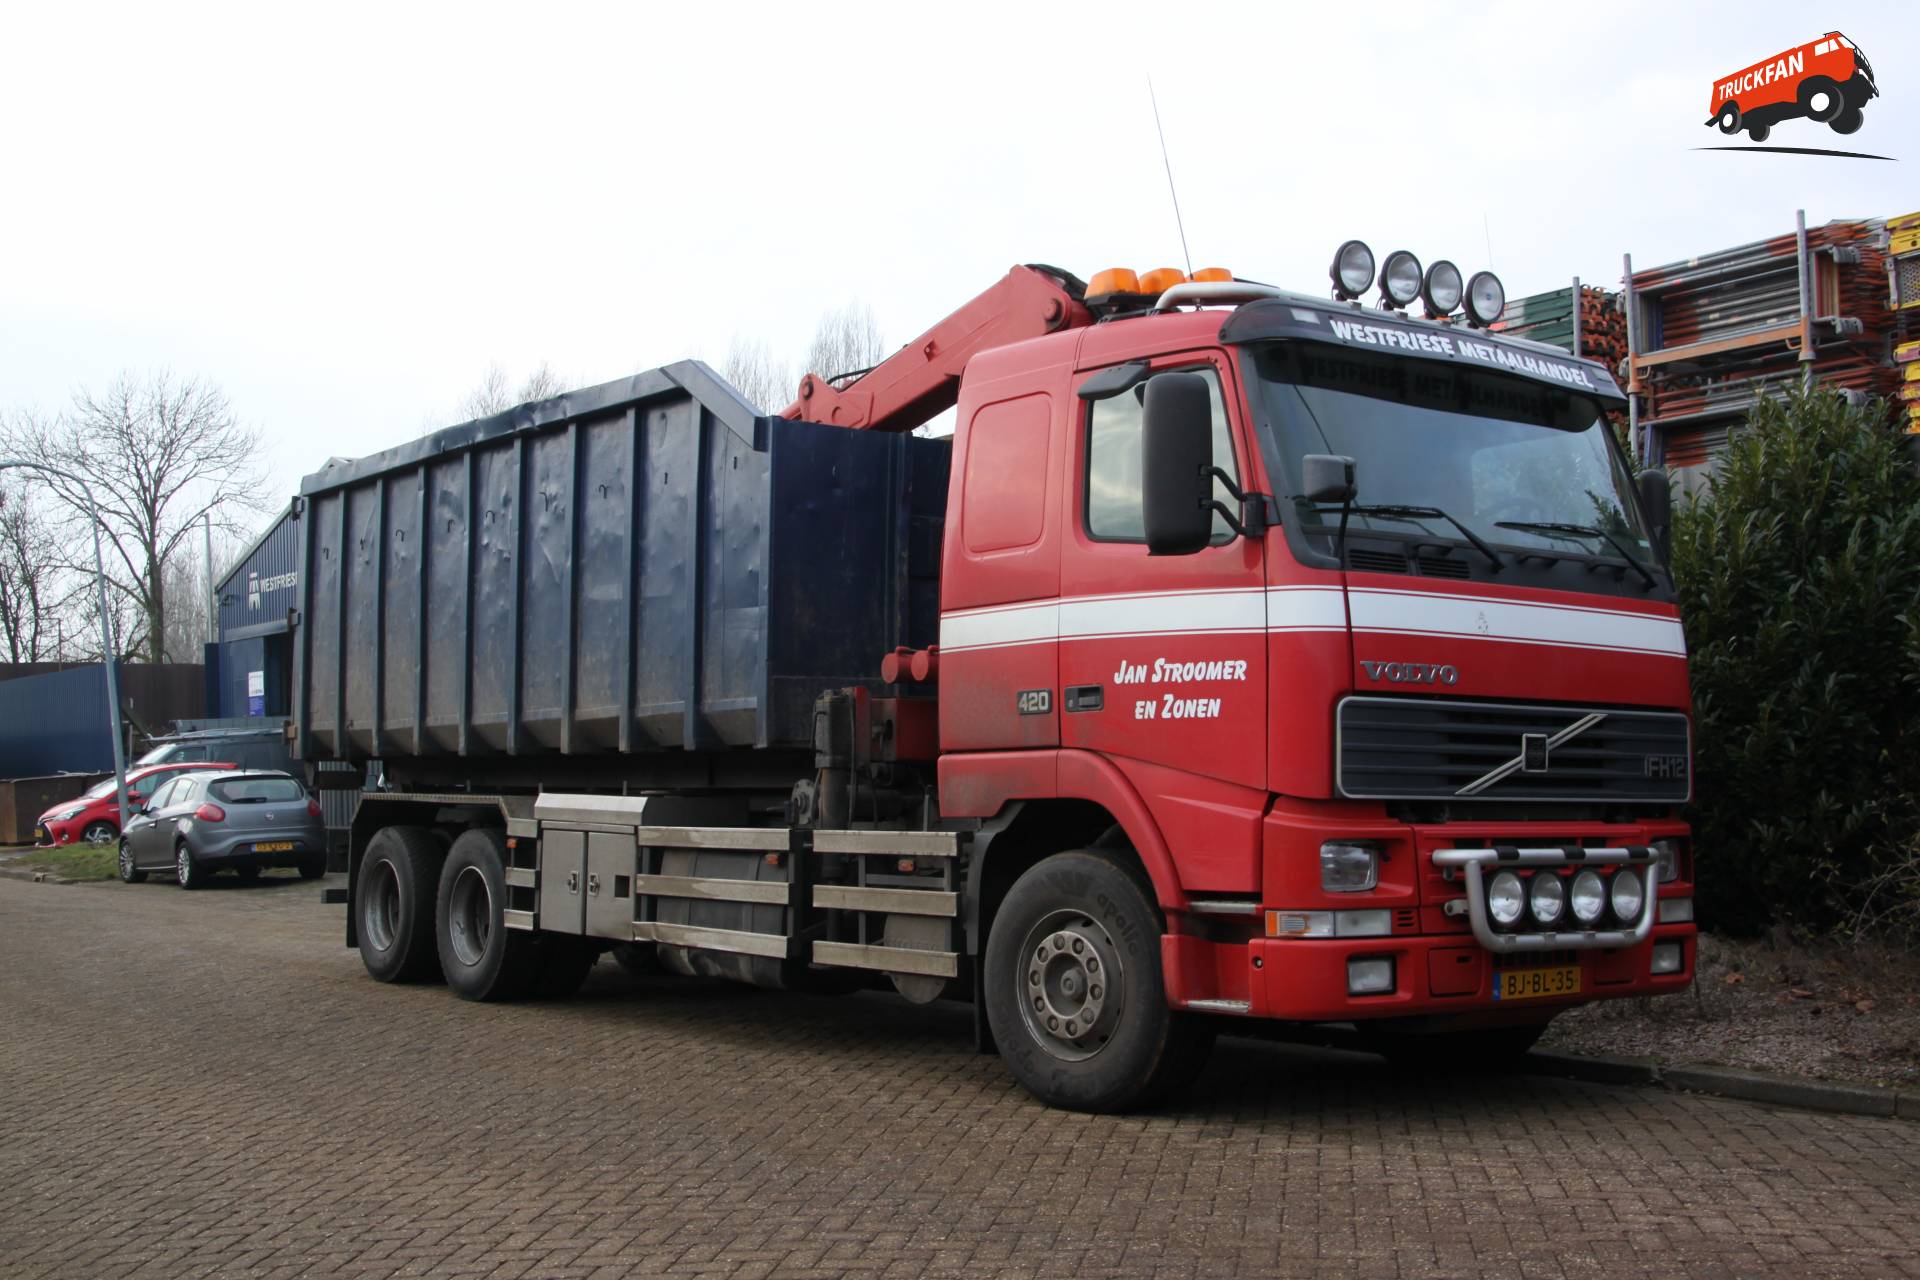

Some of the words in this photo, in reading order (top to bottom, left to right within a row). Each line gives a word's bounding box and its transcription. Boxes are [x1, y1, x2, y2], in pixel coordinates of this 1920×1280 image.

[1329, 319, 1455, 355] WESTFRIESE
[1458, 339, 1595, 389] METAALHANDEL
[1360, 660, 1459, 686] VOLVO
[1018, 691, 1049, 712] 420
[1649, 757, 1686, 778] FH12
[1507, 970, 1574, 996] BJ-BL-35
